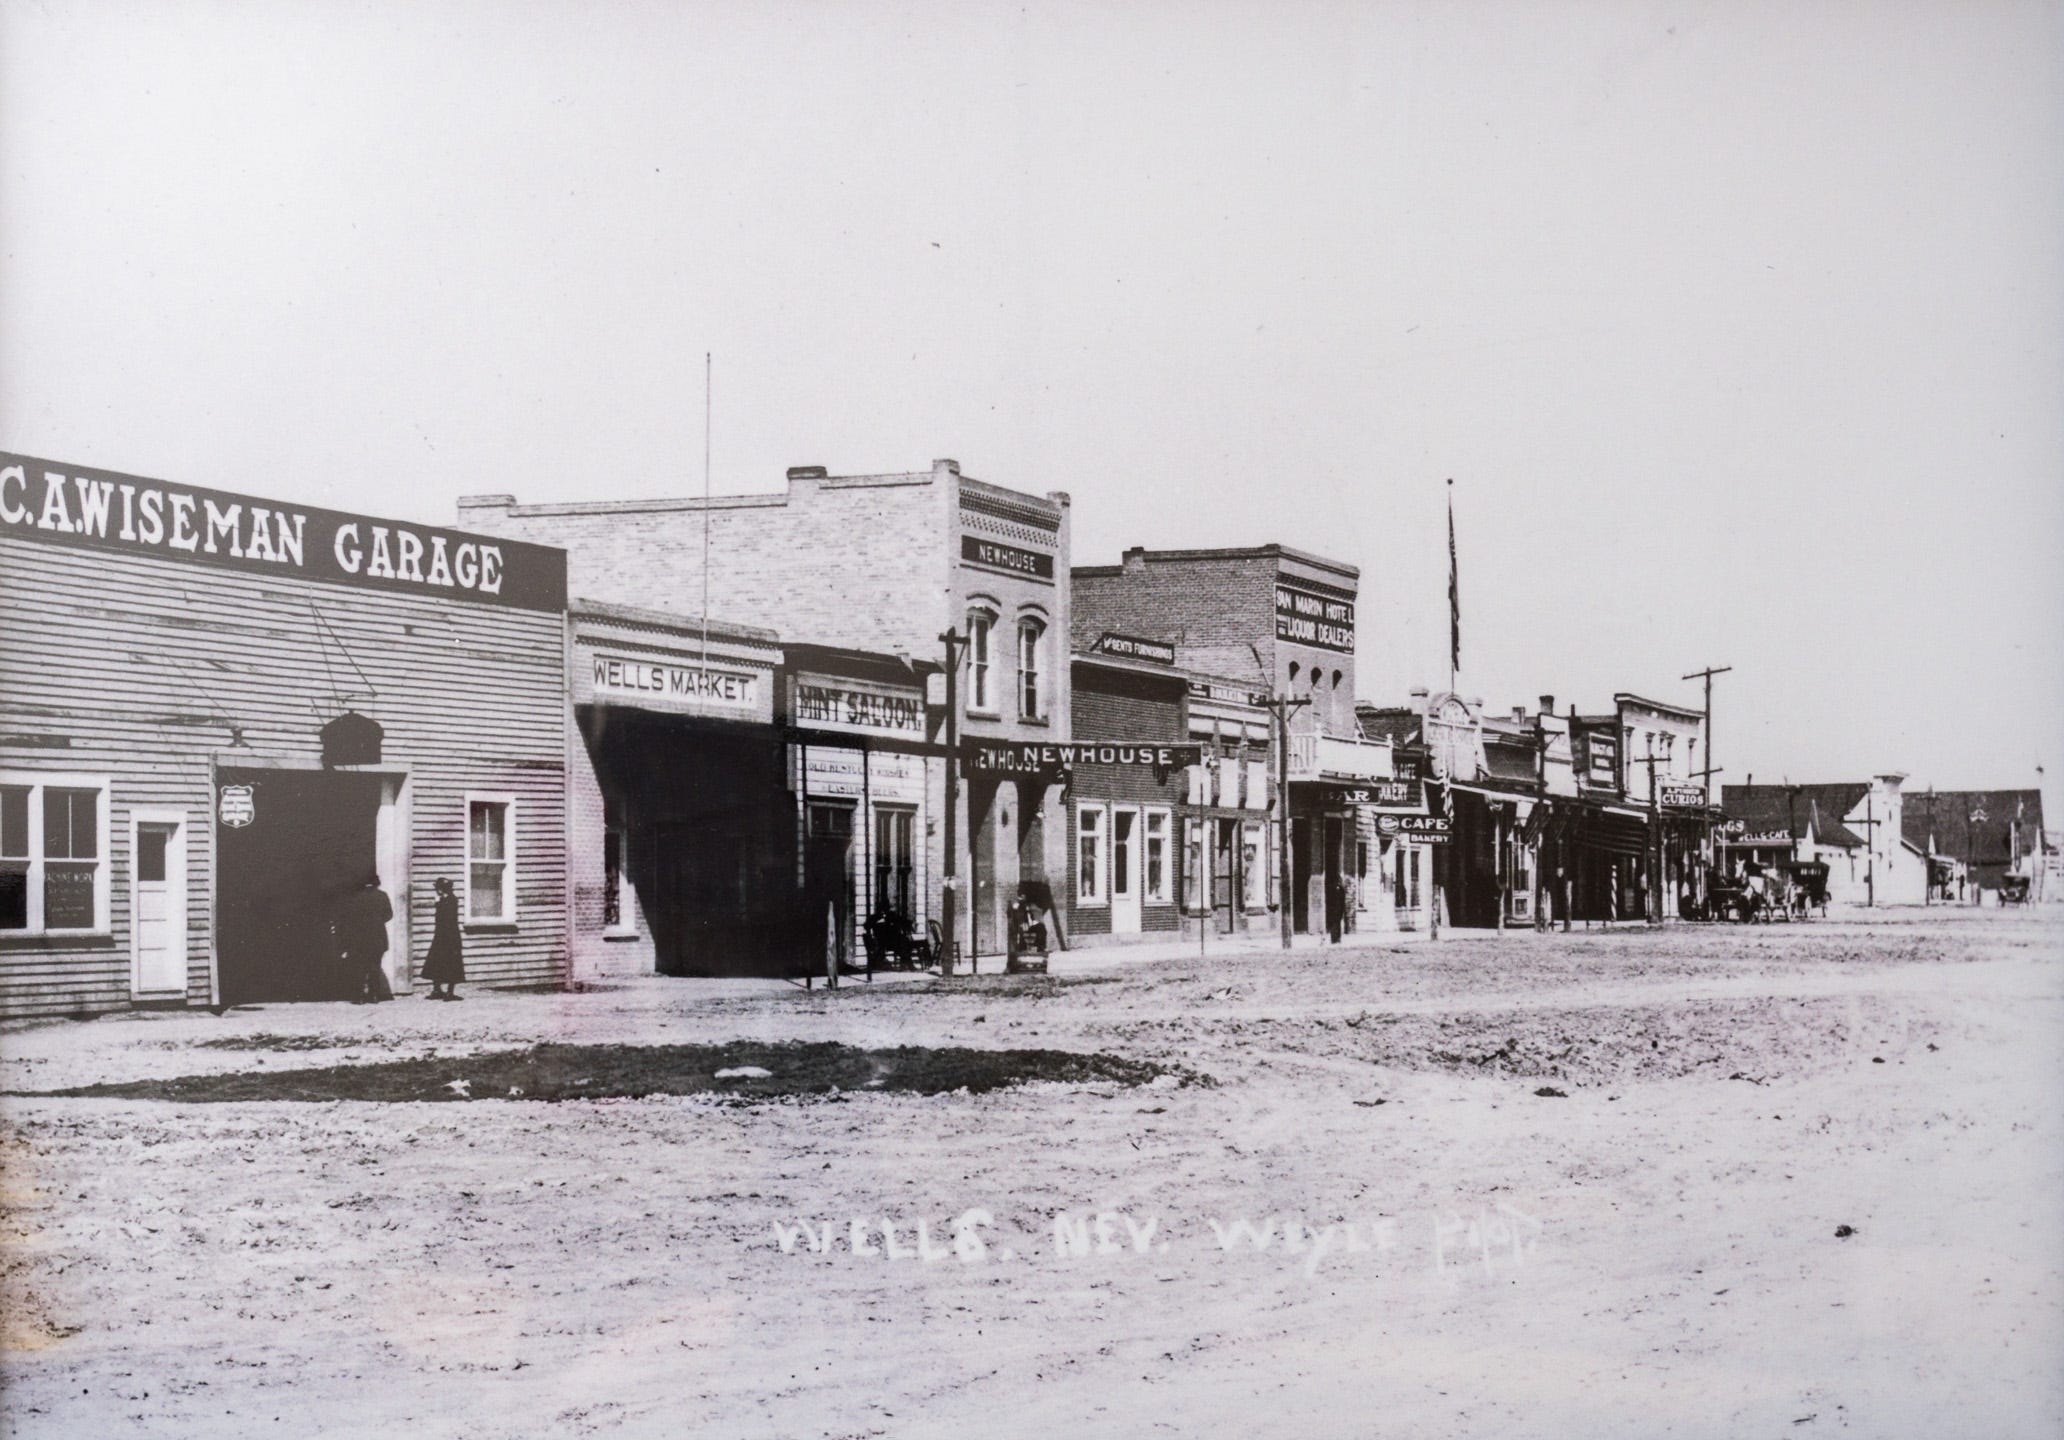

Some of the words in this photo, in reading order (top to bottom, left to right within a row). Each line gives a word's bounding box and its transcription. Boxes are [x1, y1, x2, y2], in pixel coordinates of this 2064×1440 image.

[334, 523, 503, 595] GARAGE
[979, 544, 1036, 573] NEWHOUSE
[1276, 590, 1292, 609] SAN
[1295, 594, 1323, 617] MARIN
[1288, 616, 1316, 640] LIQUOR
[1318, 623, 1354, 649] DEALERS
[593, 659, 664, 692] WELLS
[670, 670, 752, 702] MARKET.
[799, 685, 842, 722] MINT
[1024, 746, 1174, 765] NEWHOUSE
[1662, 794, 1704, 805] CURIOS
[1401, 818, 1449, 830] CAFE
[1410, 834, 1450, 842] BAKERY
